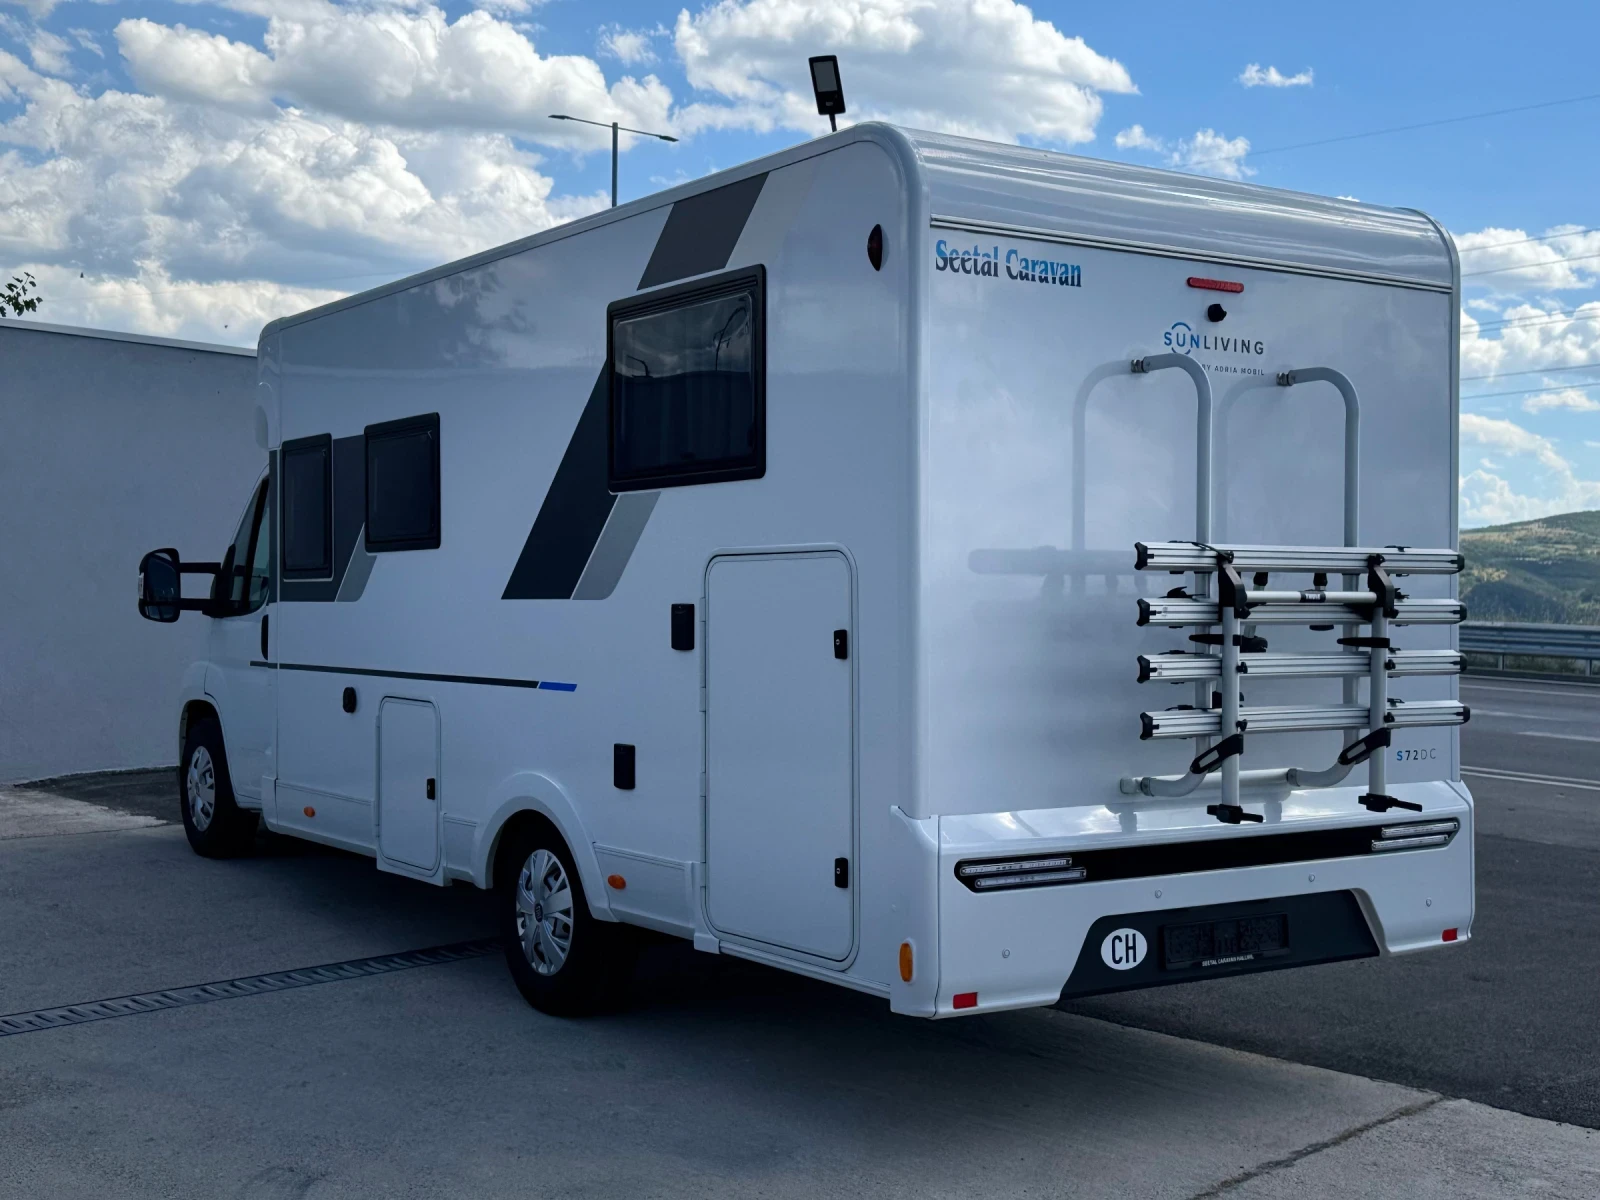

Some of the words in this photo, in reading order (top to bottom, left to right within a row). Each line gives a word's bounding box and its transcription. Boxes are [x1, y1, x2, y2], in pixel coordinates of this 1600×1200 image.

[935, 239, 999, 278] Seetal
[1005, 248, 1082, 288] Caravan
[1214, 365, 1238, 374] ADRIA
[1241, 367, 1265, 376] MOBIL
[1111, 933, 1137, 965] CH
